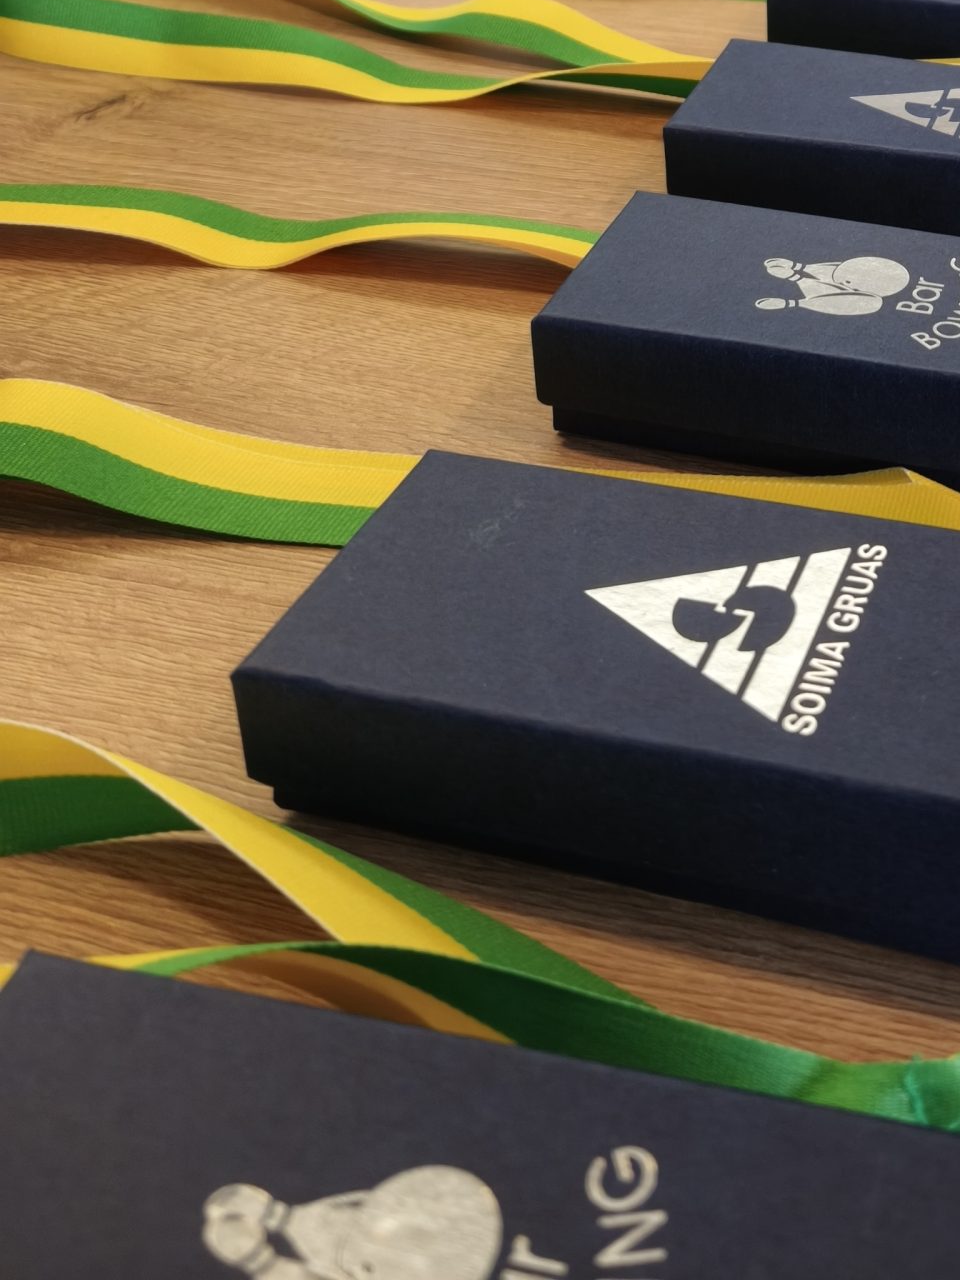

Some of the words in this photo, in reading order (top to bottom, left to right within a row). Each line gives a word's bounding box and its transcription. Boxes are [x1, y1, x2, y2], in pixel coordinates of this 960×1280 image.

[896, 276, 945, 315] Bar
[781, 641, 850, 737] SOIMA
[826, 543, 889, 634] GRUAS
